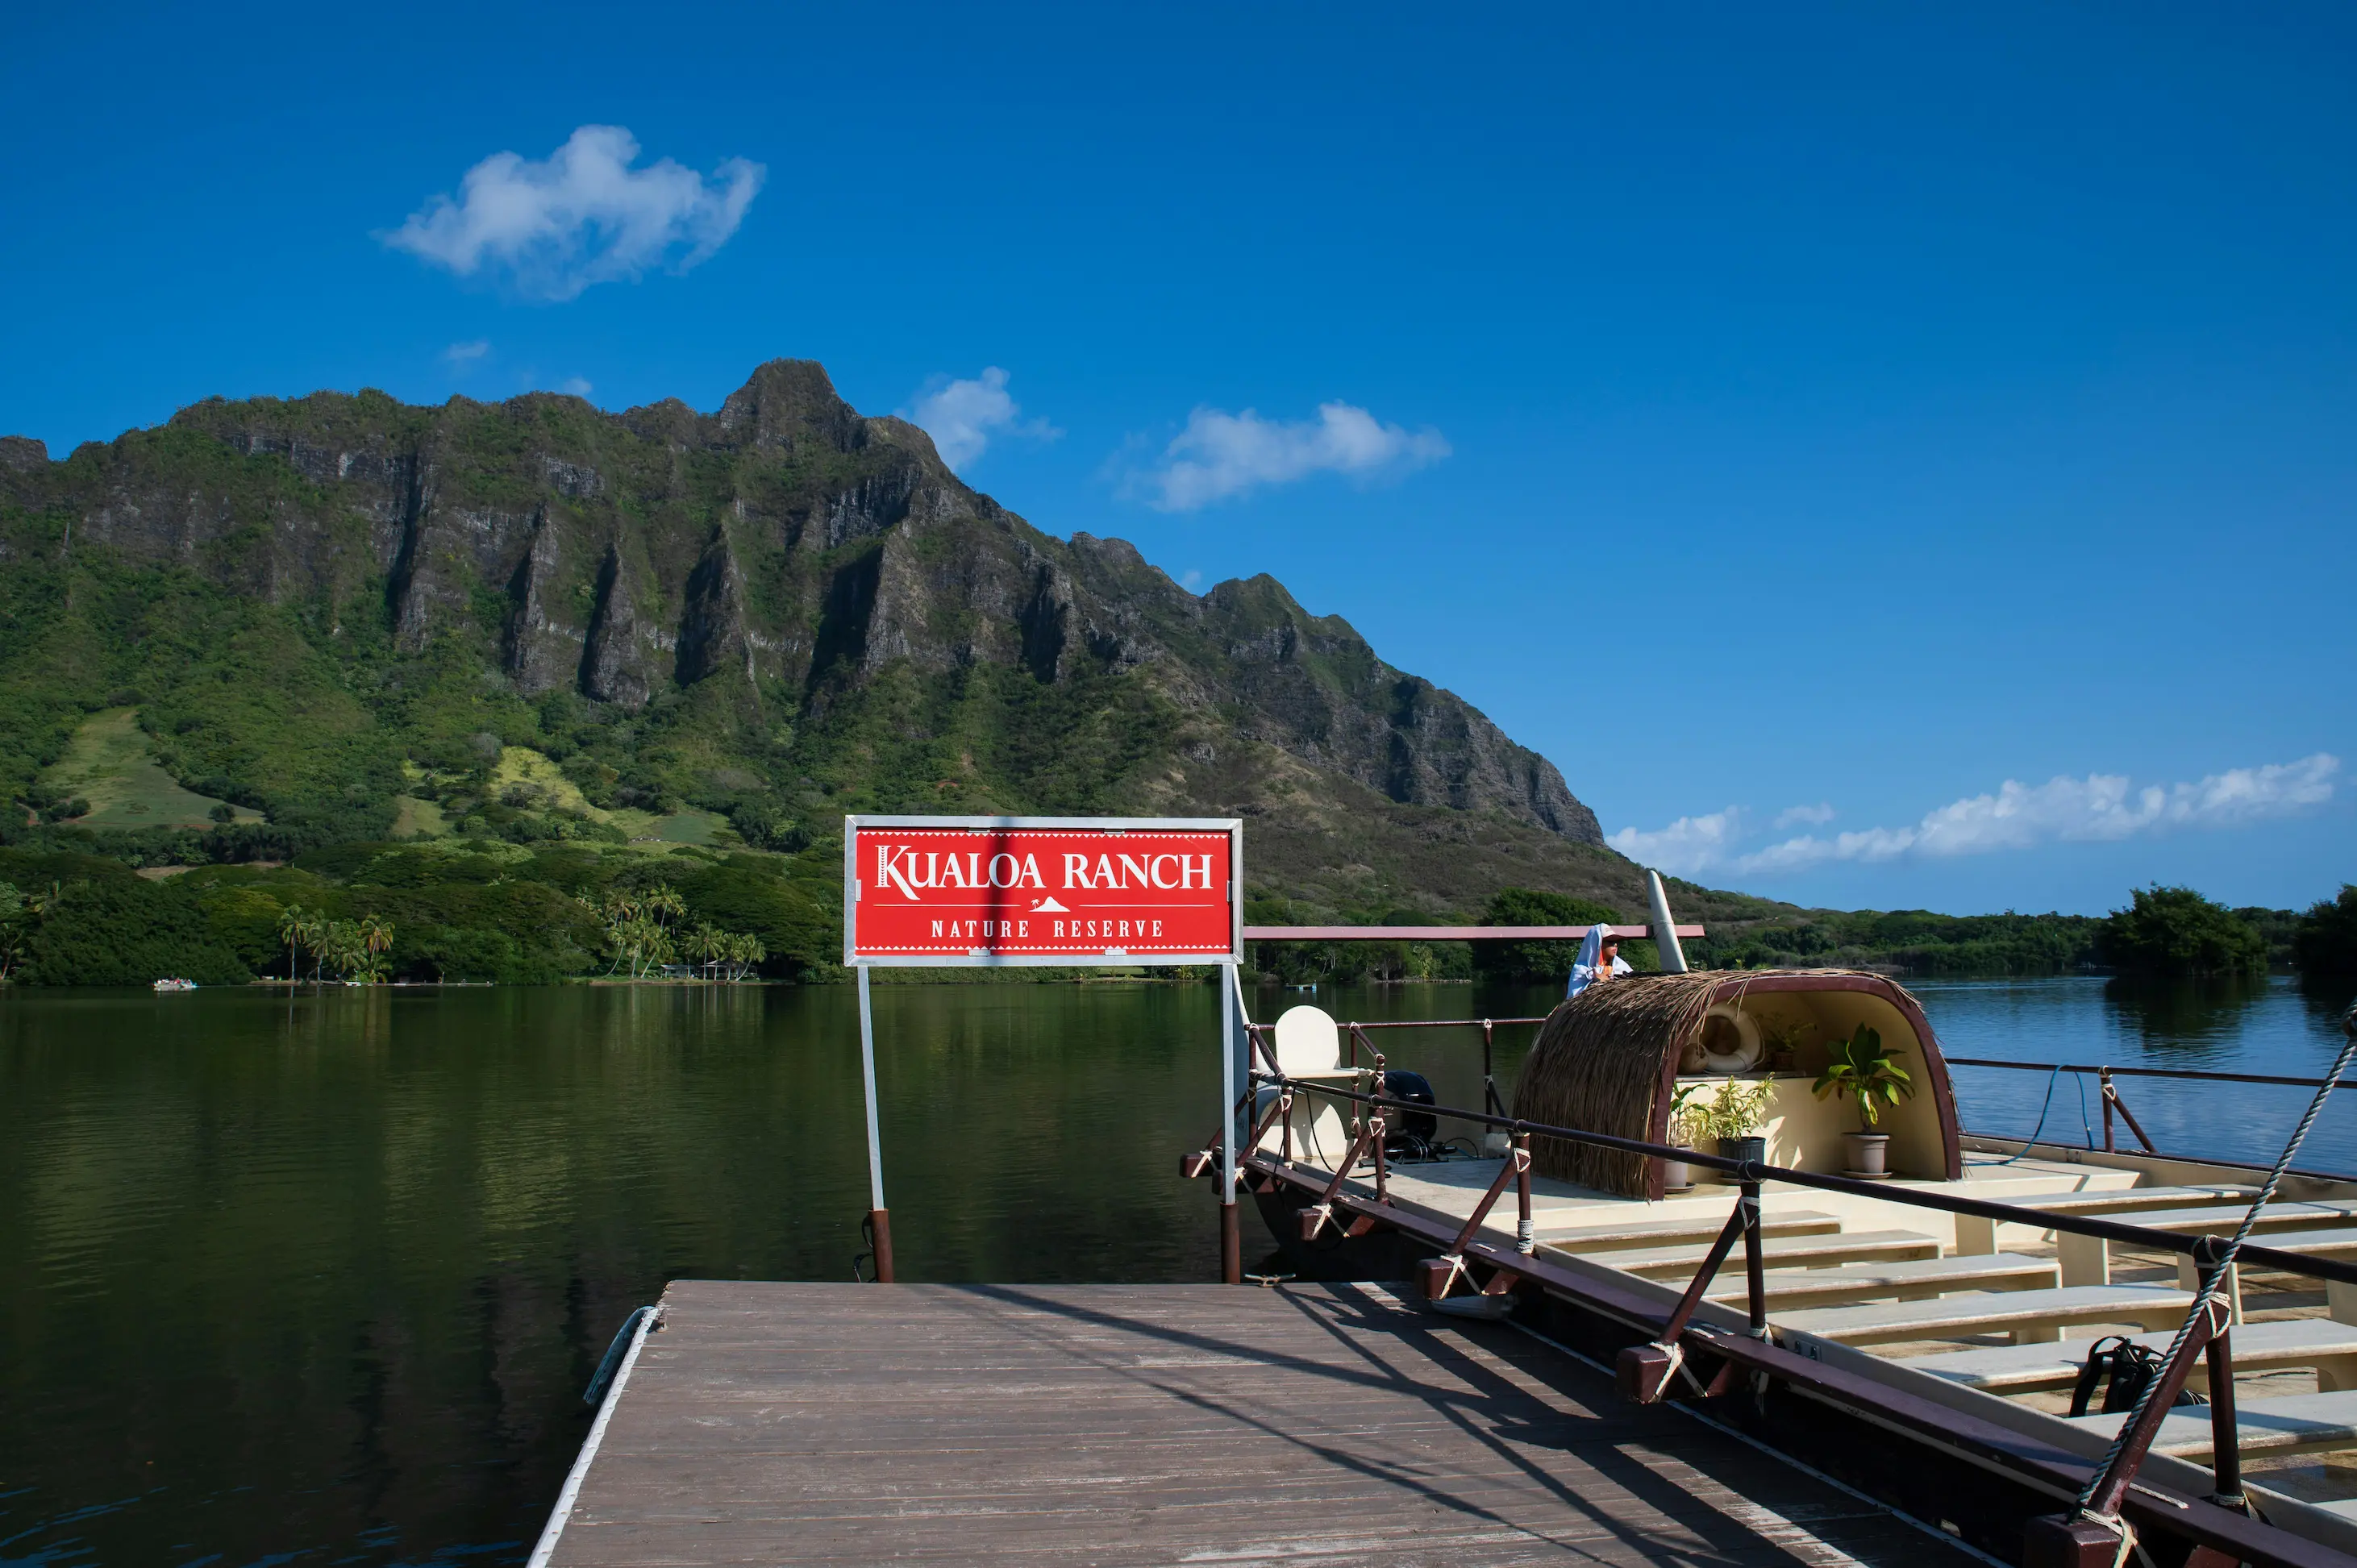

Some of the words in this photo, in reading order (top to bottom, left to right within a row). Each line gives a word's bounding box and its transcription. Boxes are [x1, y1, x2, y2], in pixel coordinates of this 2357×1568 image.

[875, 845, 1047, 900] KUALOA
[1061, 853, 1214, 889] RANCH
[931, 920, 1029, 938] NATURE
[1053, 920, 1163, 938] RESERVE
